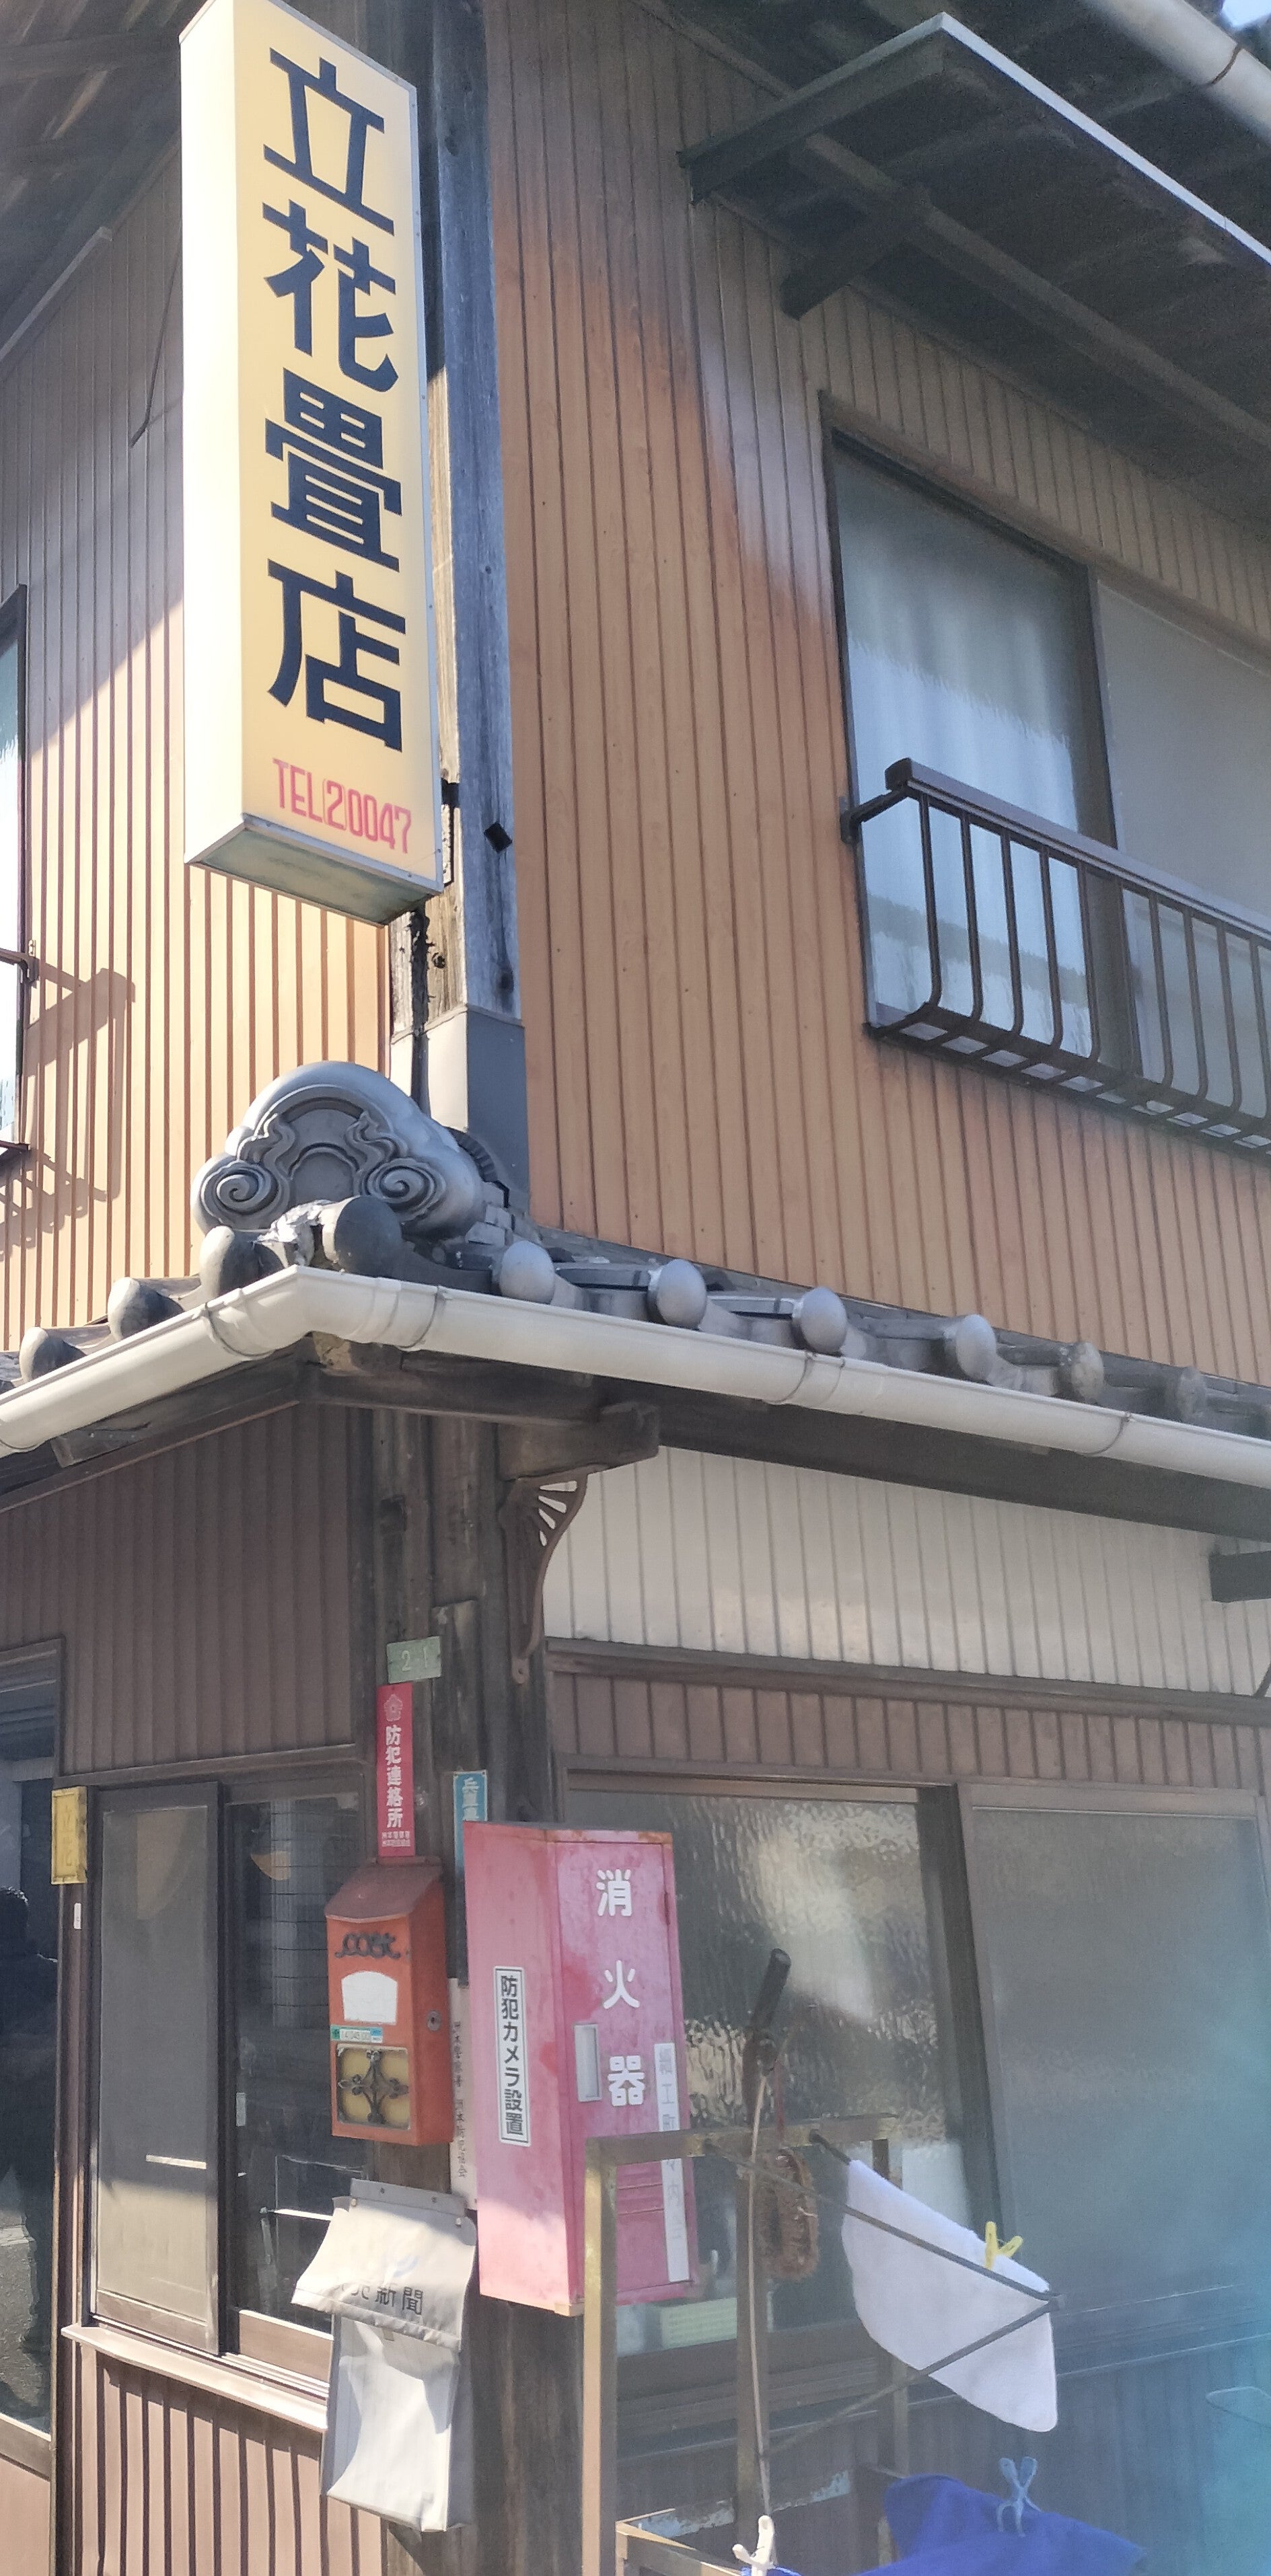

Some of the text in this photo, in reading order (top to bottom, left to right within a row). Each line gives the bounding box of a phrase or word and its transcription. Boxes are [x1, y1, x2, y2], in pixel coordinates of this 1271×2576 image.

[263, 47, 406, 753] 立花畳店
[385, 1724, 404, 1828] 防犯連絡所
[501, 1975, 523, 2135] 防犯カメラ設置
[596, 1868, 646, 2107] 消火器
